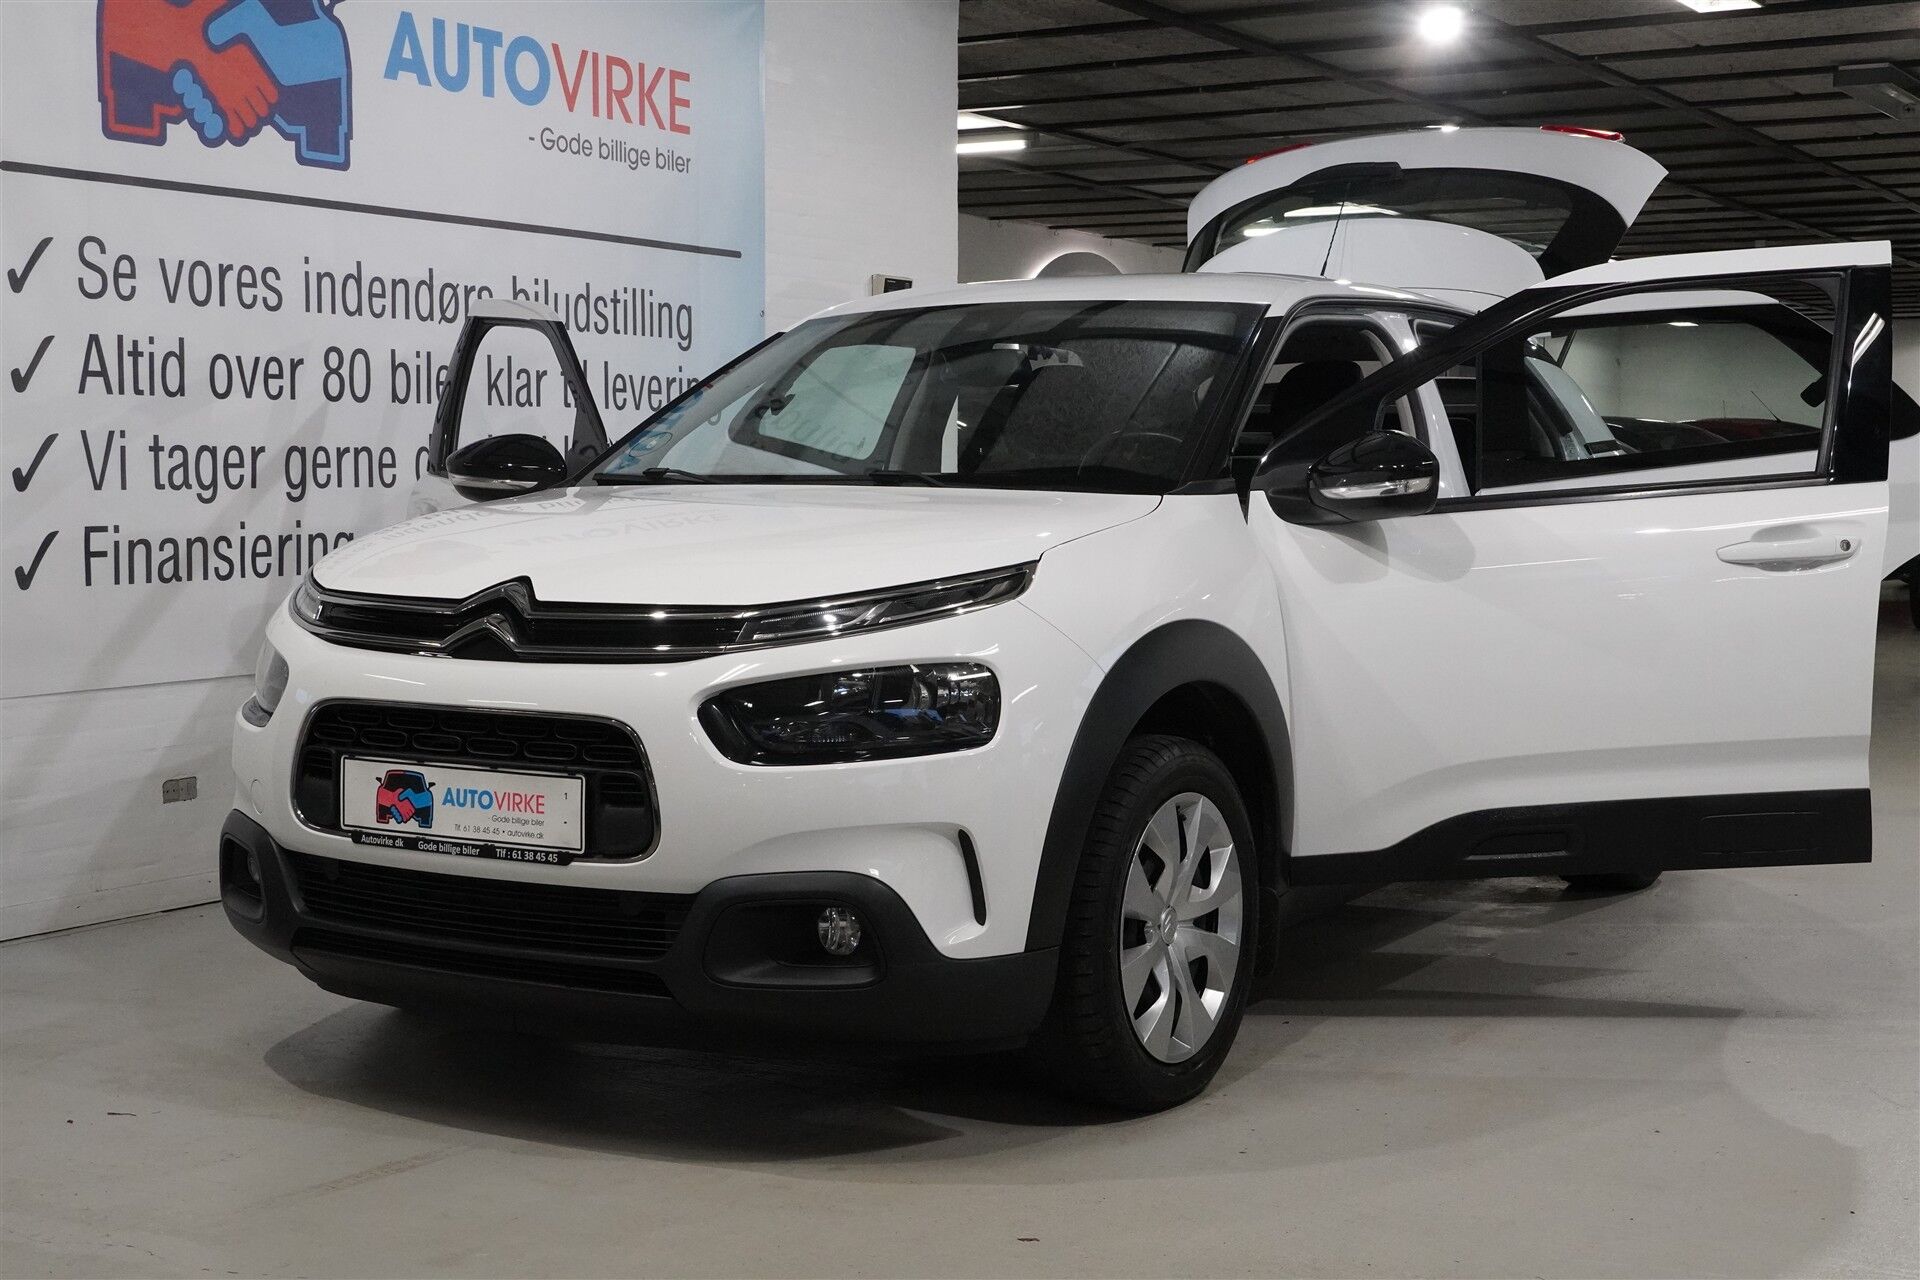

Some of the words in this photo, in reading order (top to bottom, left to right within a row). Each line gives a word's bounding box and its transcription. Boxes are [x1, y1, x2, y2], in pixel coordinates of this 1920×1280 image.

[383, 10, 690, 135] AUTOVIRKE
[540, 127, 593, 157] Gode
[598, 137, 650, 170] billige
[655, 147, 691, 173] biler
[77, 235, 136, 301] Se
[158, 257, 283, 312] vores
[78, 333, 185, 398] Altid
[209, 352, 304, 401] over
[322, 345, 371, 403] 80
[390, 348, 450, 404] bile
[487, 354, 547, 408] klar
[80, 429, 127, 491] Vi
[149, 434, 265, 504] tager
[284, 443, 397, 503] gerne
[441, 786, 545, 814] AUTOVIRKE
[491, 814, 510, 824] Gode
[511, 816, 530, 826] billige
[531, 818, 545, 826] biler
[361, 834, 393, 846] Autovirke
[418, 840, 437, 851] Gode
[438, 841, 461, 855] billige
[462, 845, 480, 856] biler
[512, 850, 522, 860] 61
[523, 851, 534, 861] 38
[535, 852, 546, 862] 45
[547, 853, 558, 863] 45
[472, 825, 481, 833] 38
[482, 826, 491, 834] 45
[492, 827, 501, 835] 45
